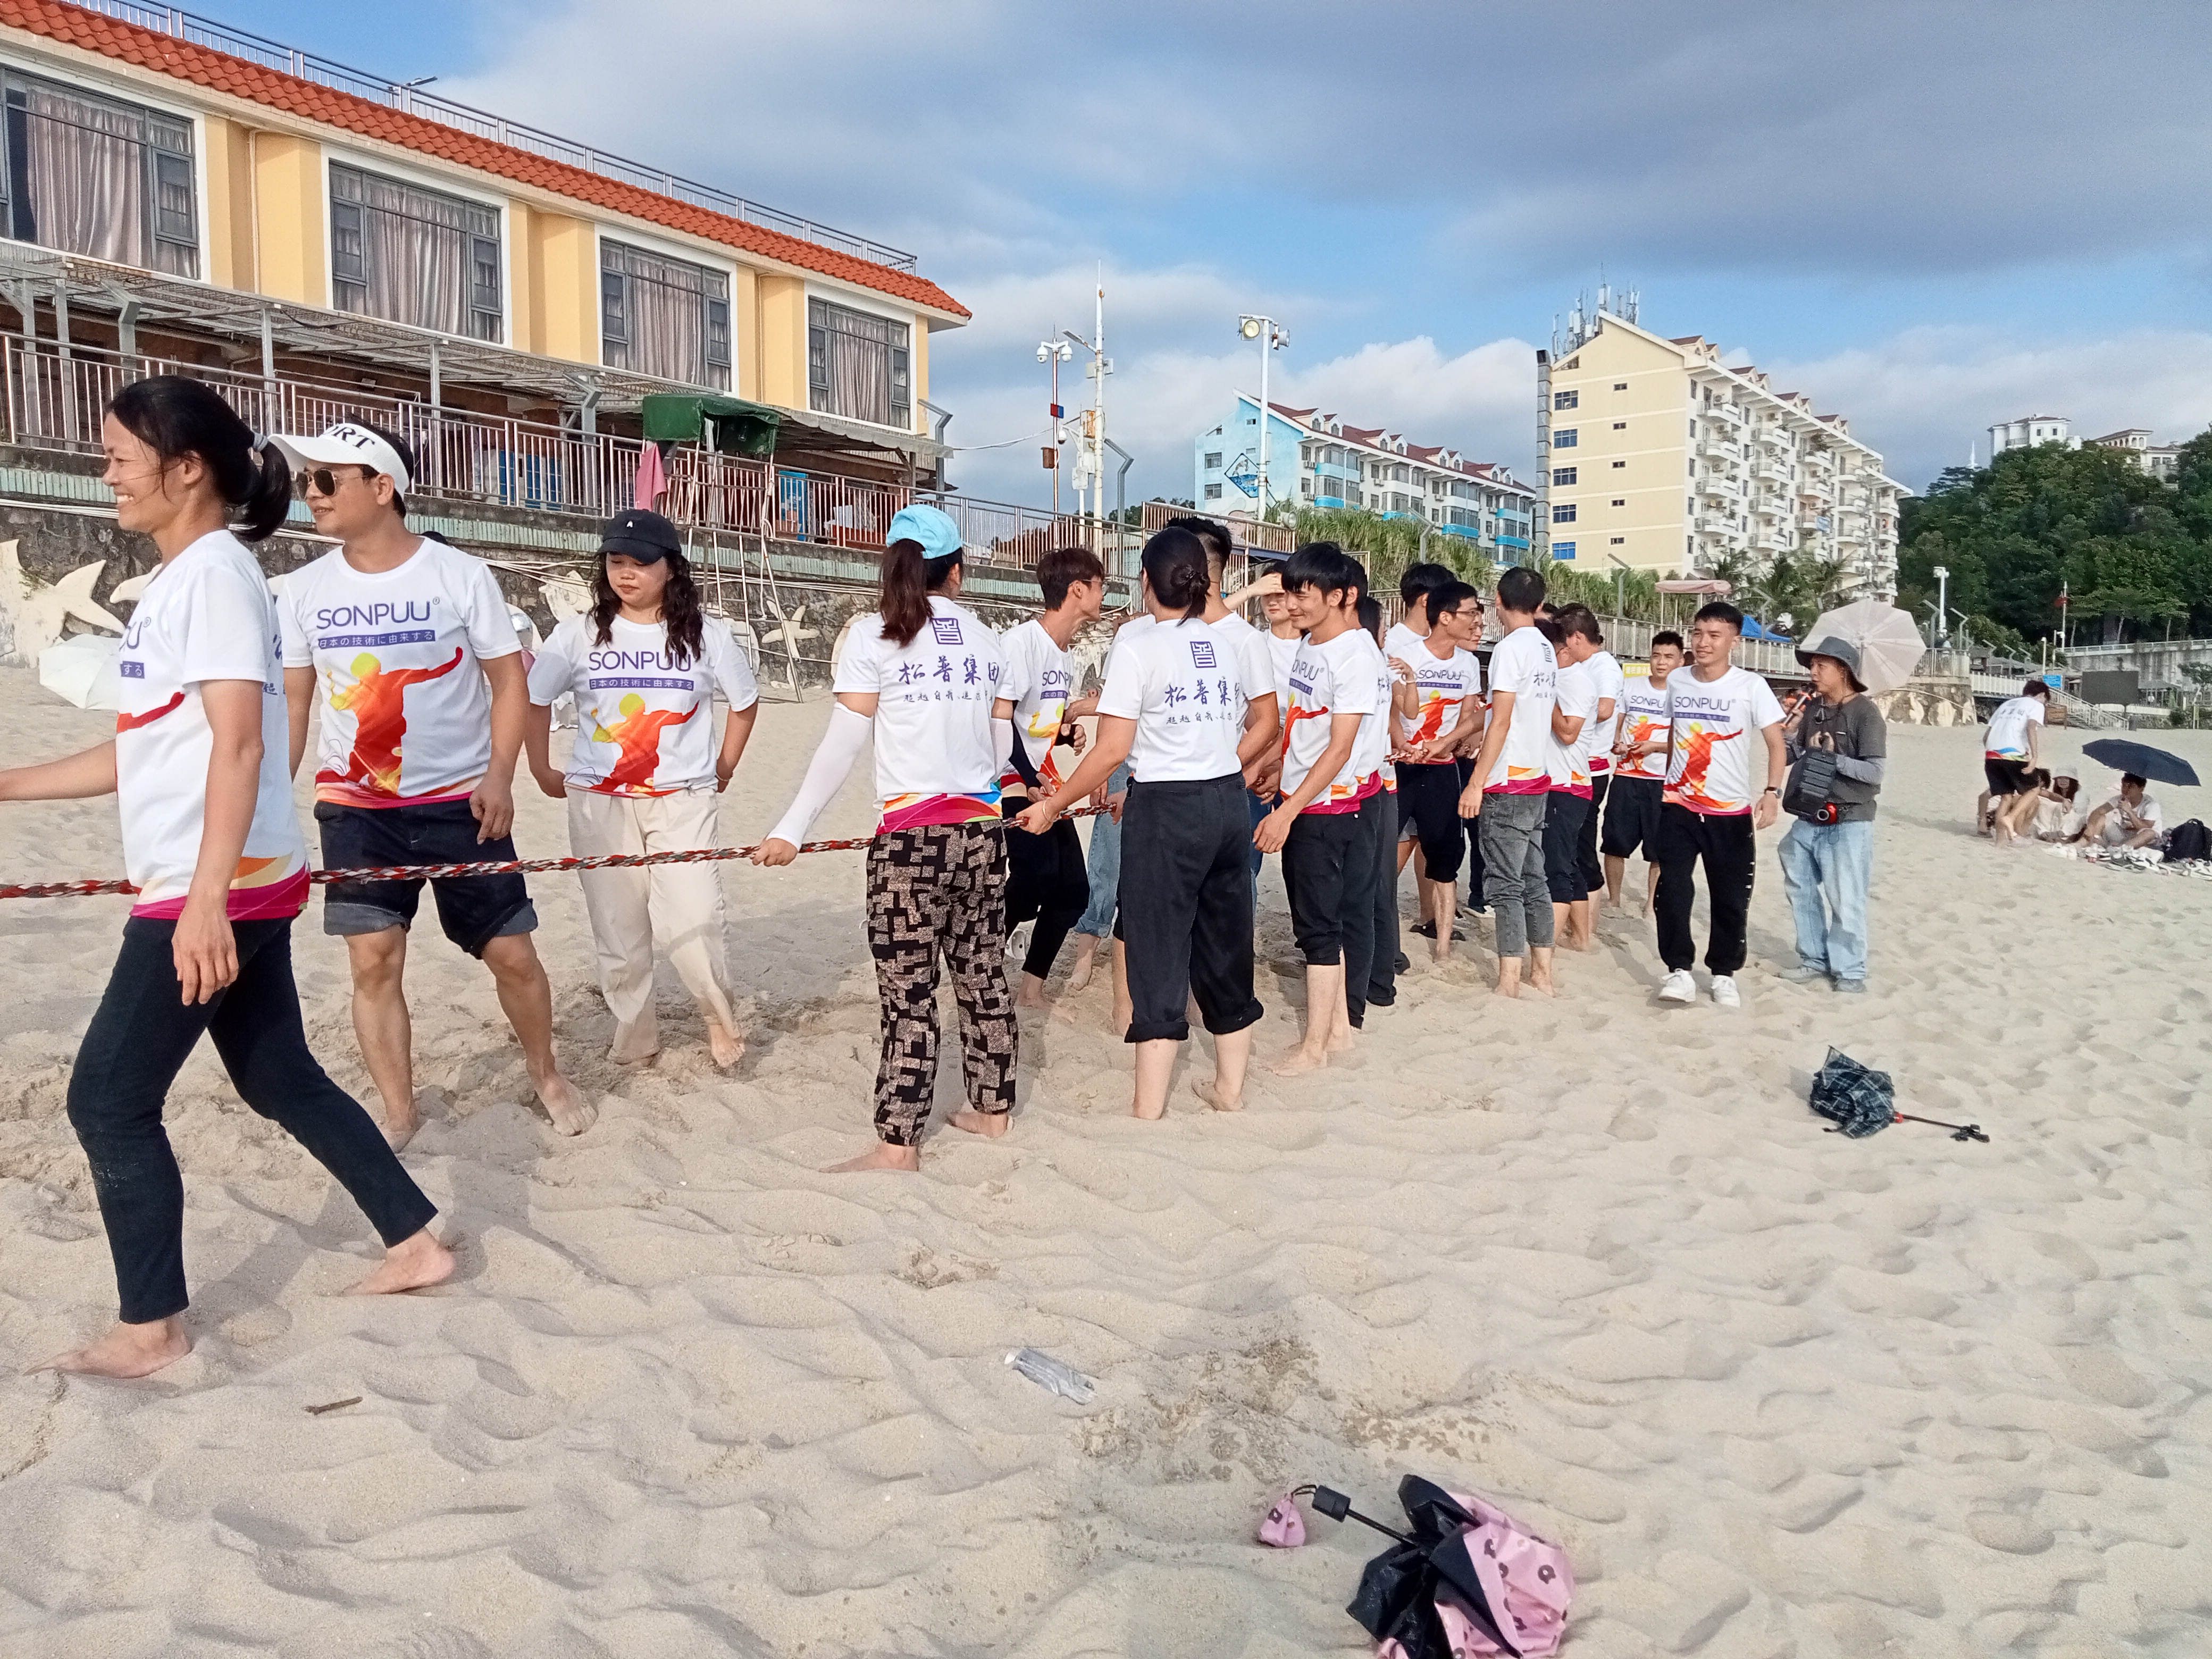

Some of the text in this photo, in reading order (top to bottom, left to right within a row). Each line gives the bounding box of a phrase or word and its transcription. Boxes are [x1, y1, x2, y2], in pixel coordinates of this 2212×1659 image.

[316, 601, 430, 630] SONPUU
[319, 631, 433, 648] 日本の技術に由来する
[589, 650, 691, 672] SONPUU
[1418, 669, 1462, 681] SONPUU
[590, 678, 693, 690] 日本の技術に由来する
[1674, 697, 1730, 711] SONPUU
